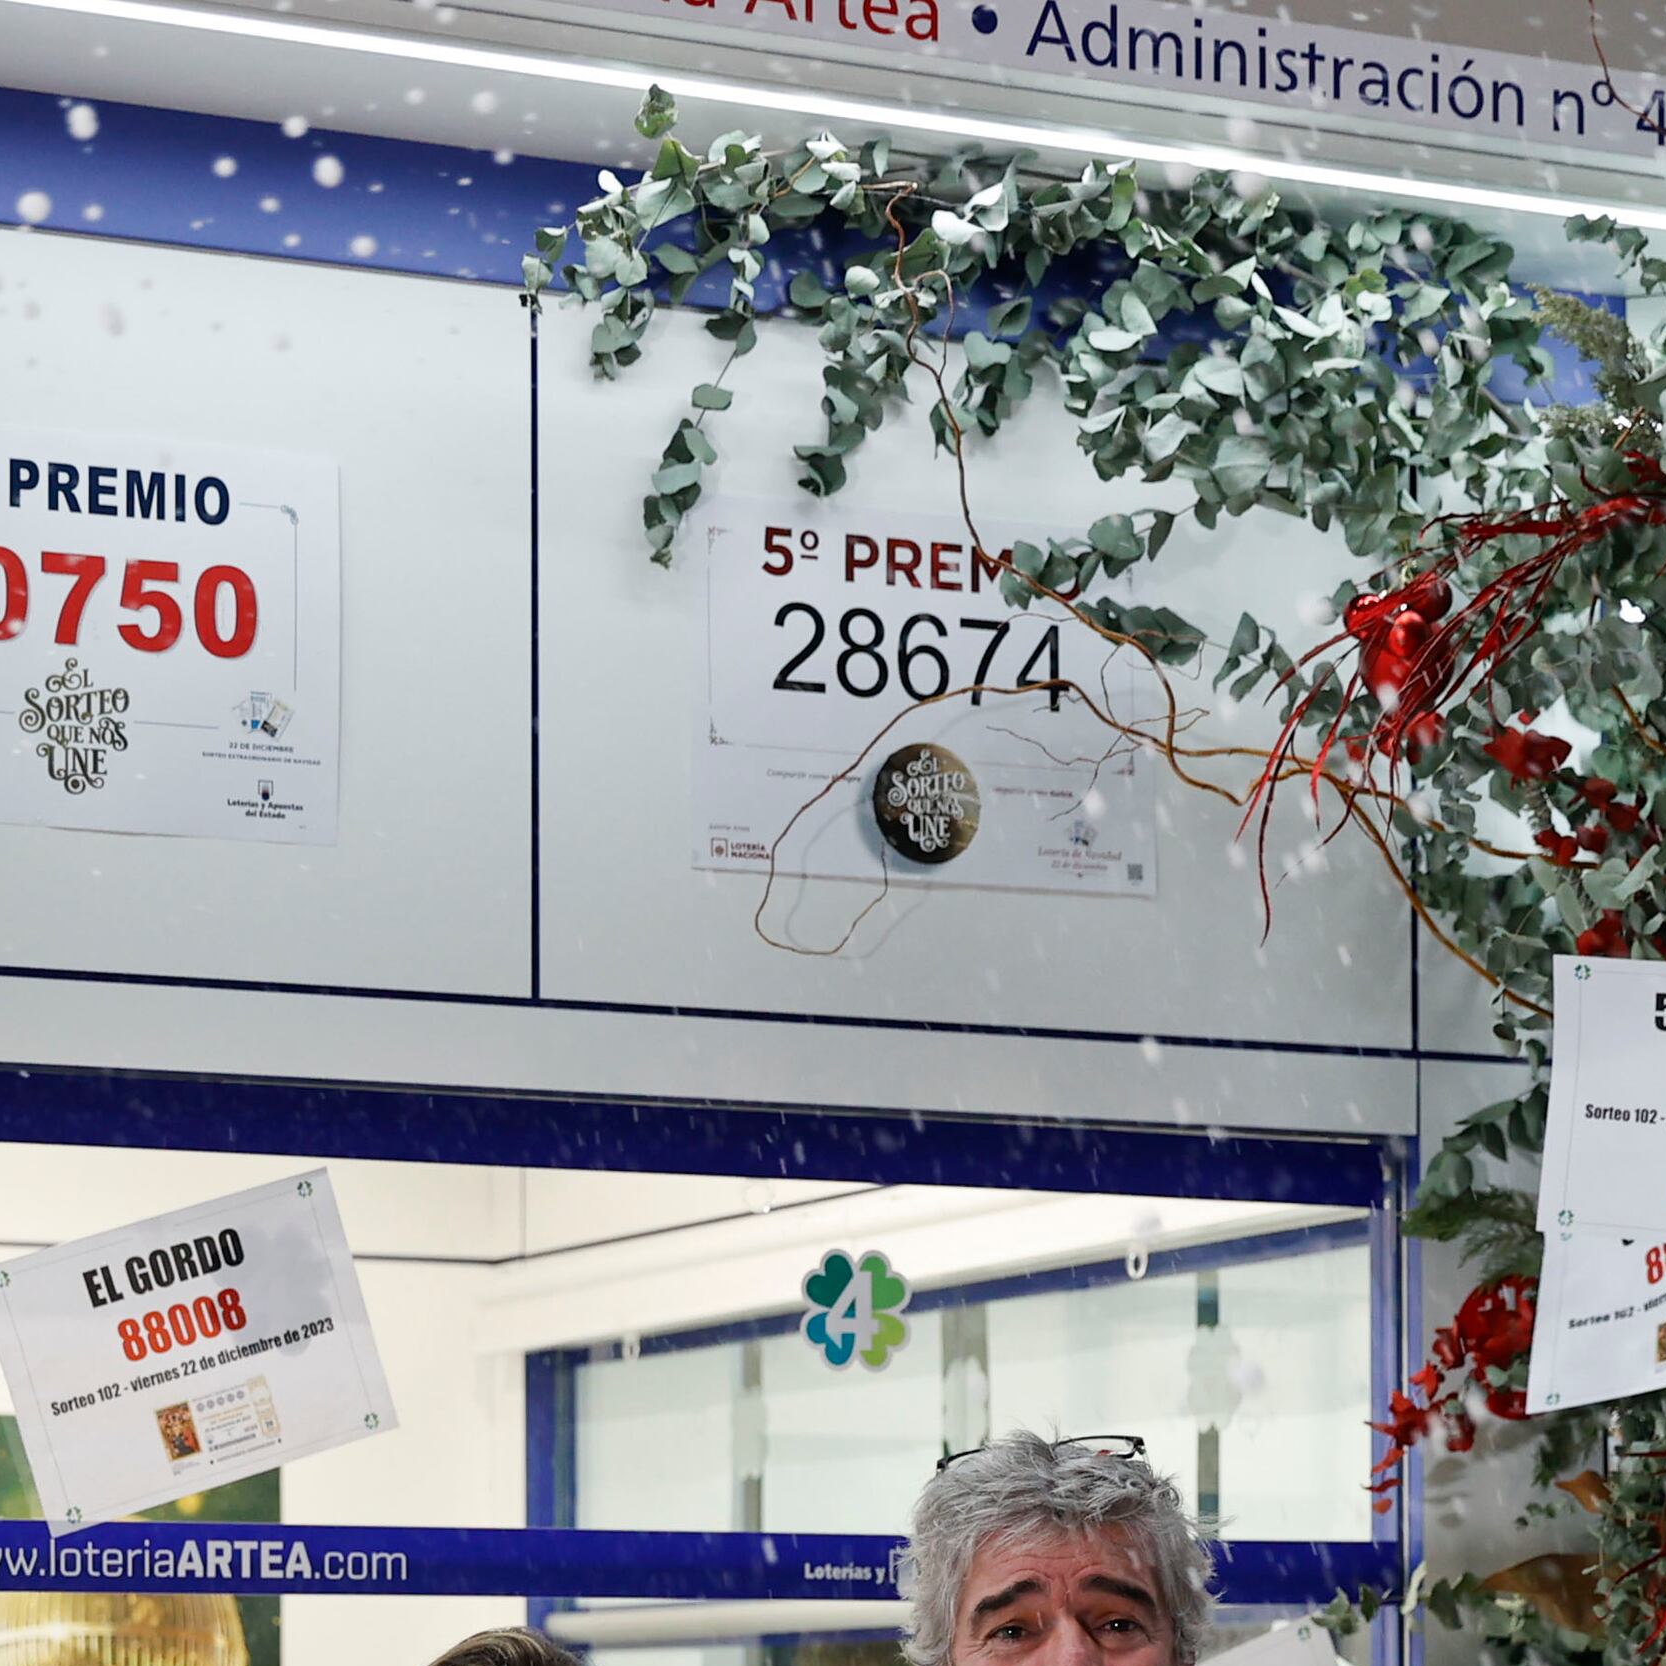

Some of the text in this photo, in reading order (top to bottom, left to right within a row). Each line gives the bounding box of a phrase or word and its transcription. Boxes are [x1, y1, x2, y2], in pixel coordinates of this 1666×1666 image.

[1026, 0, 1524, 126] Administración
[9, 458, 230, 526] PREMIO
[763, 526, 1082, 601] 5º PREM
[45, 657, 94, 693] EL
[772, 602, 1070, 713] 28674
[19, 687, 130, 734] SORTEO
[46, 717, 129, 752] QUE NOS
[36, 742, 108, 794] UNE
[82, 1227, 245, 1308] EL GORDO
[116, 1289, 247, 1361] 88008
[50, 1316, 334, 1417] Sorteo 102 viernes 22 de diciembre de 2023
[804, 1561, 872, 1581] Loterías
